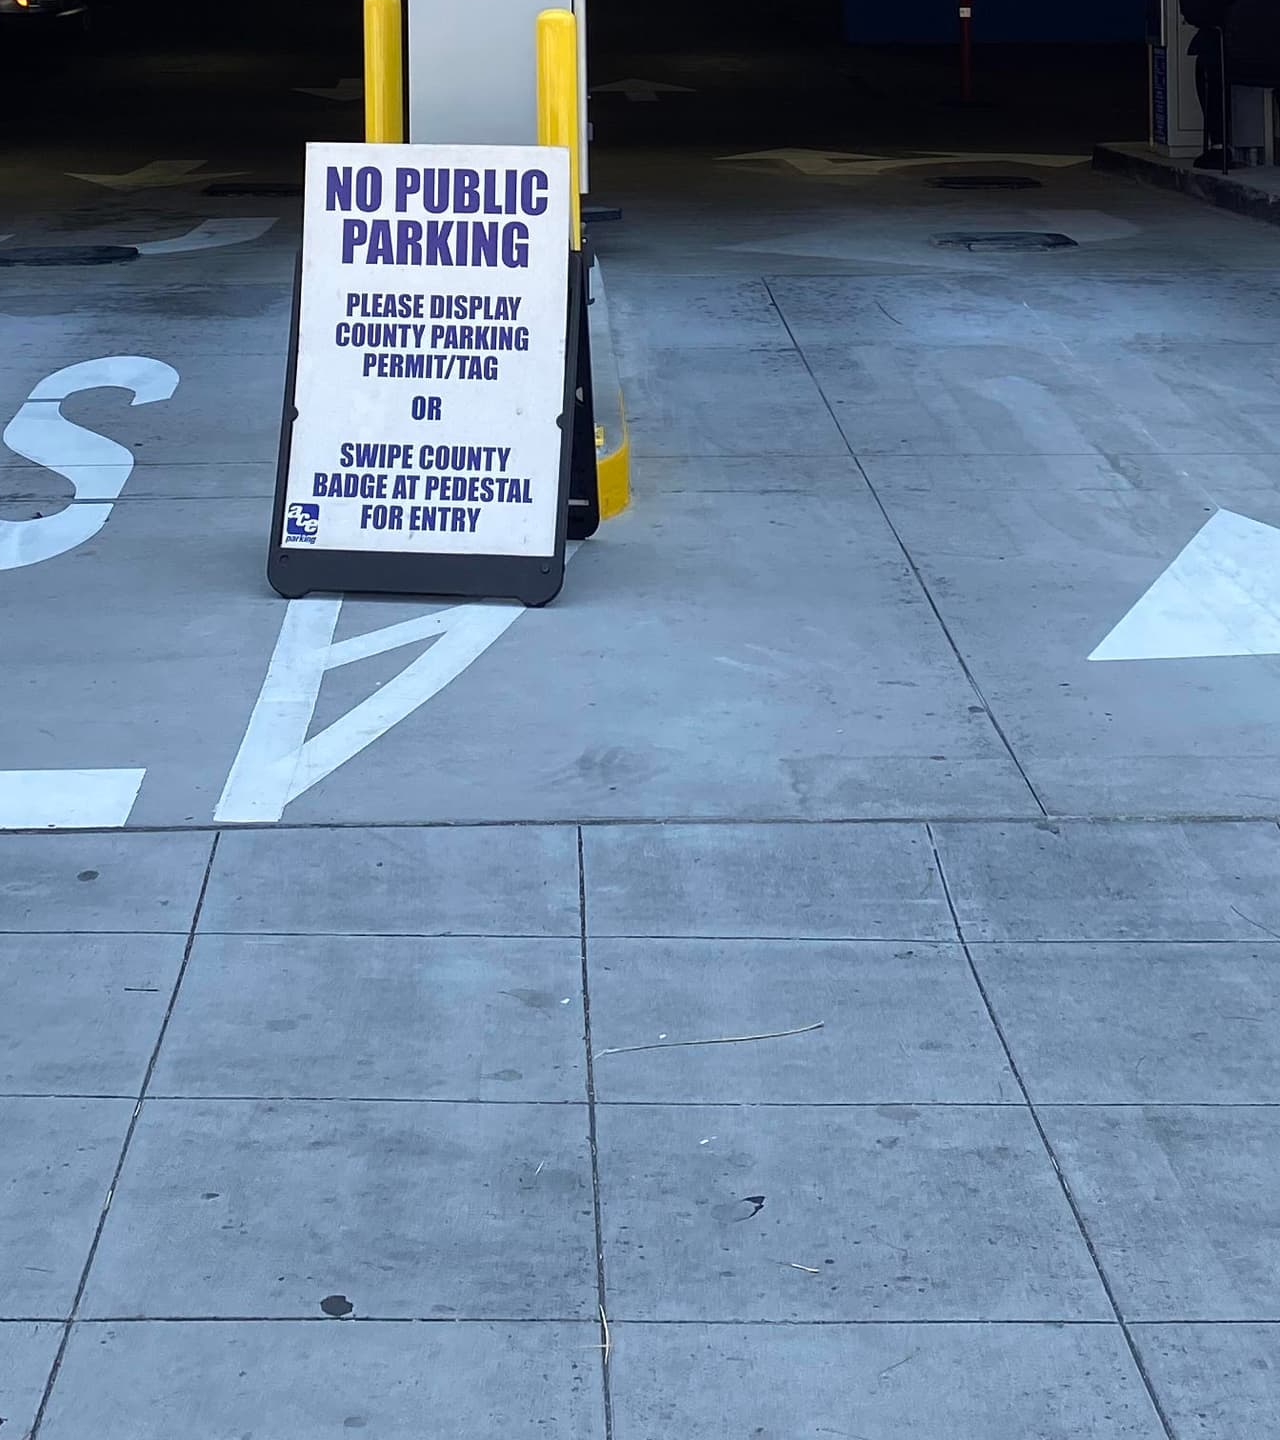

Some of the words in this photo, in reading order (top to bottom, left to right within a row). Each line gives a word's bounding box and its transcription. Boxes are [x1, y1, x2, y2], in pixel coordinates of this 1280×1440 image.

[326, 166, 383, 212] NO
[395, 167, 549, 216] PUBLIC
[342, 219, 529, 268] PARKING
[346, 293, 425, 319] PLEASE
[430, 294, 522, 321] DISPLAY
[335, 322, 426, 348] COUNTY
[430, 325, 529, 351] PARKING
[363, 353, 499, 380] PERMIT/TAG
[411, 396, 442, 421] OR
[340, 442, 414, 469] SWIPE
[419, 445, 511, 472] COUNTY
[312, 472, 388, 499] BADGE
[392, 475, 421, 500] AT
[424, 476, 533, 504] PEDESTAL
[287, 505, 319, 533] ace
[360, 504, 404, 530] FOR
[409, 506, 482, 532] ENTRY
[285, 534, 317, 545] parking
